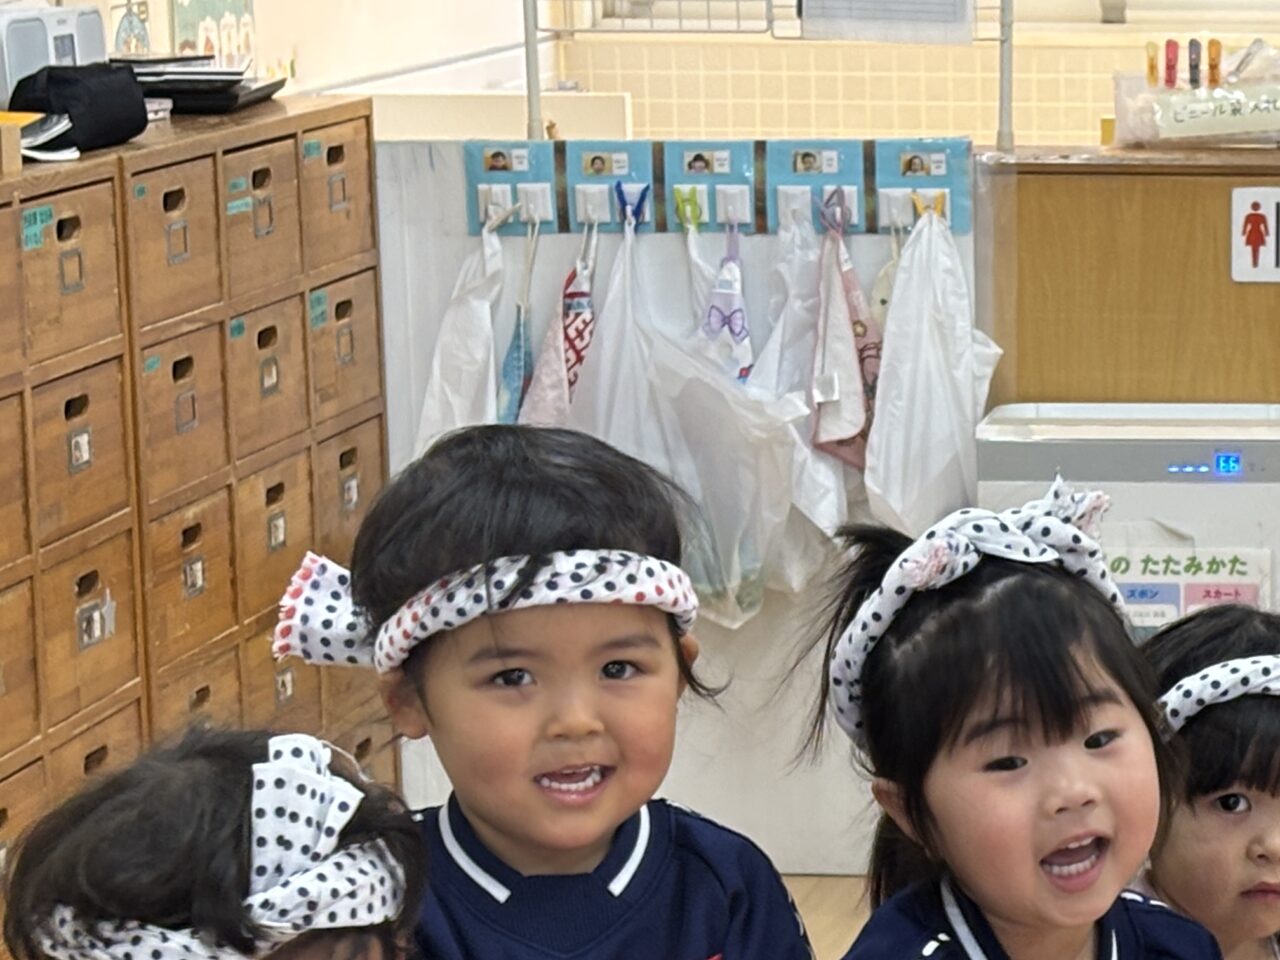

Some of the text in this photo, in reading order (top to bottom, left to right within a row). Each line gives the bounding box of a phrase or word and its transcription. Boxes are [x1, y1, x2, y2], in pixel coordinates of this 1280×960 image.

[1140, 554, 1248, 576] たたみかた
[1126, 588, 1160, 600] ズボン
[1202, 588, 1242, 599] スカート
